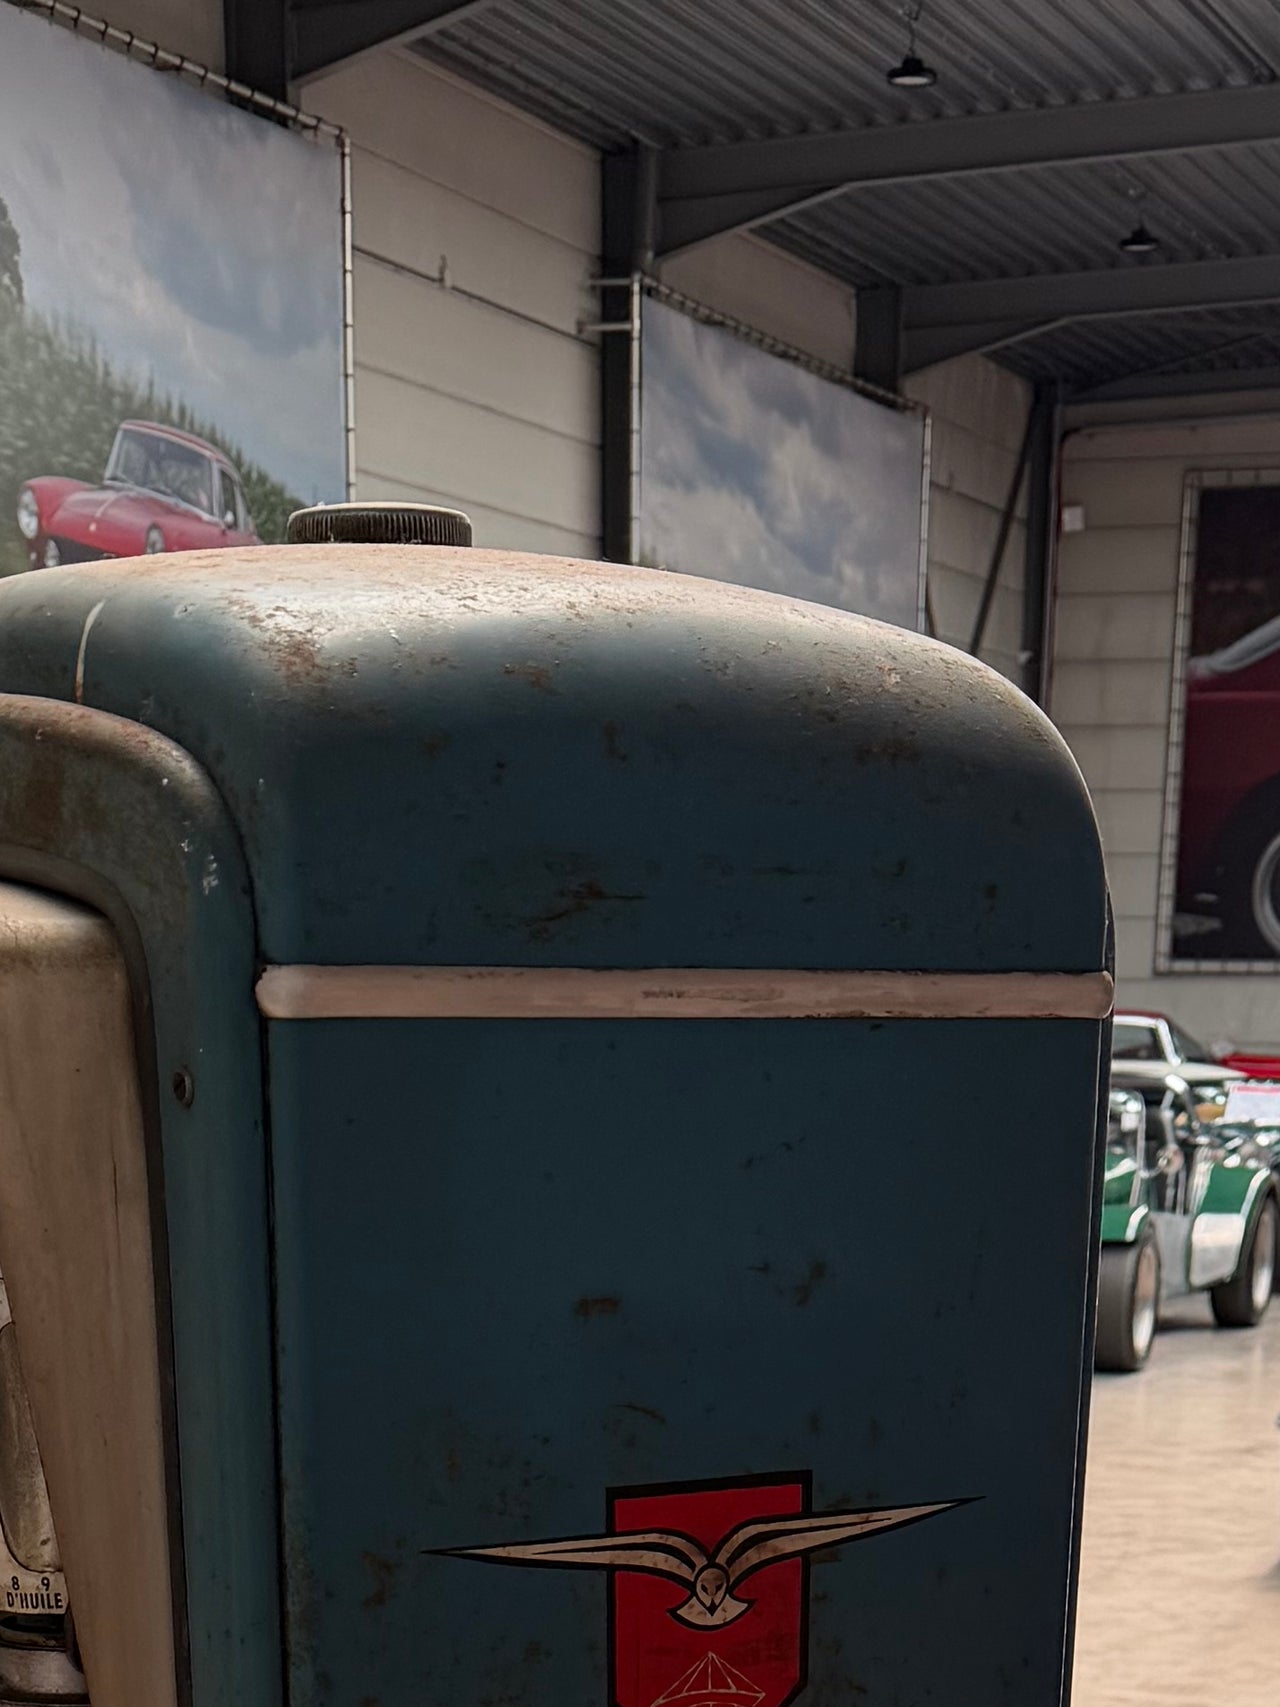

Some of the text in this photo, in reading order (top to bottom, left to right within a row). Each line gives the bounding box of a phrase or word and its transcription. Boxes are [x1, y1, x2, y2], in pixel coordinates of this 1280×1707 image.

[11, 1576, 20, 1591] 8
[41, 1577, 50, 1592] 9
[6, 1591, 64, 1609] D'HUILE
